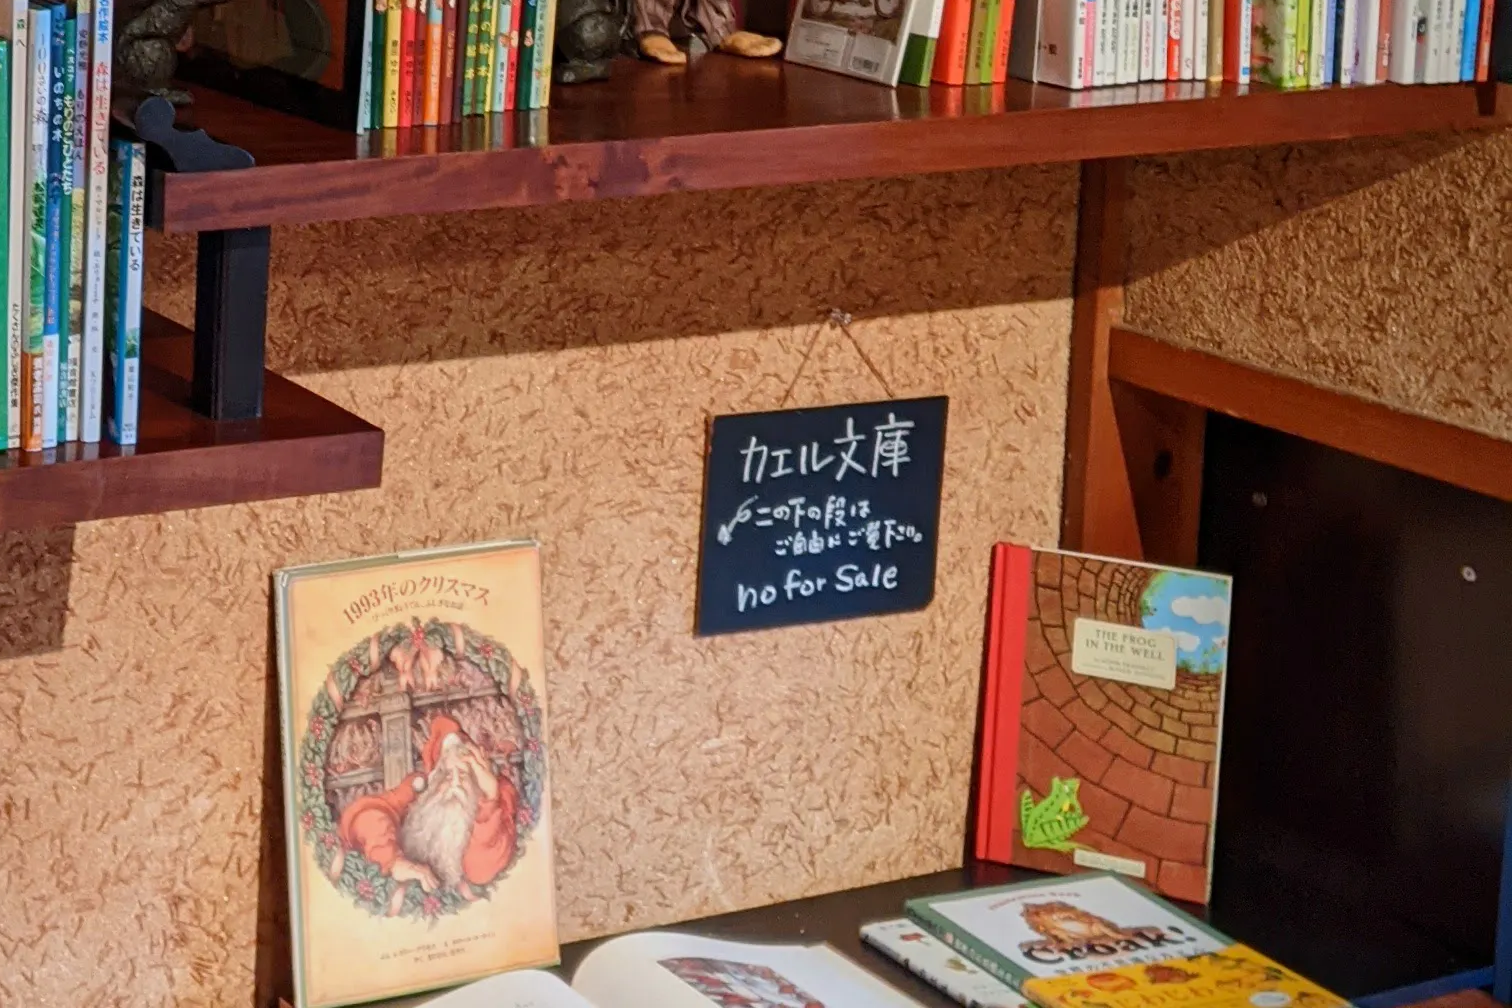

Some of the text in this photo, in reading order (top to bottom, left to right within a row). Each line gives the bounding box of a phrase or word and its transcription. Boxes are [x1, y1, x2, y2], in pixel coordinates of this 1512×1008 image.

[91, 60, 108, 175] 森は生きている
[129, 175, 144, 272] 森は生きている
[739, 411, 916, 484] カエル文庫
[755, 494, 872, 530] この下の段は
[342, 575, 491, 625] 1993年のクリスマス
[737, 563, 899, 613] no for Sale
[1085, 638, 1166, 662] IN THE WELL
[1095, 628, 1157, 649] THE FROG
[1020, 925, 1198, 966] Croak!
